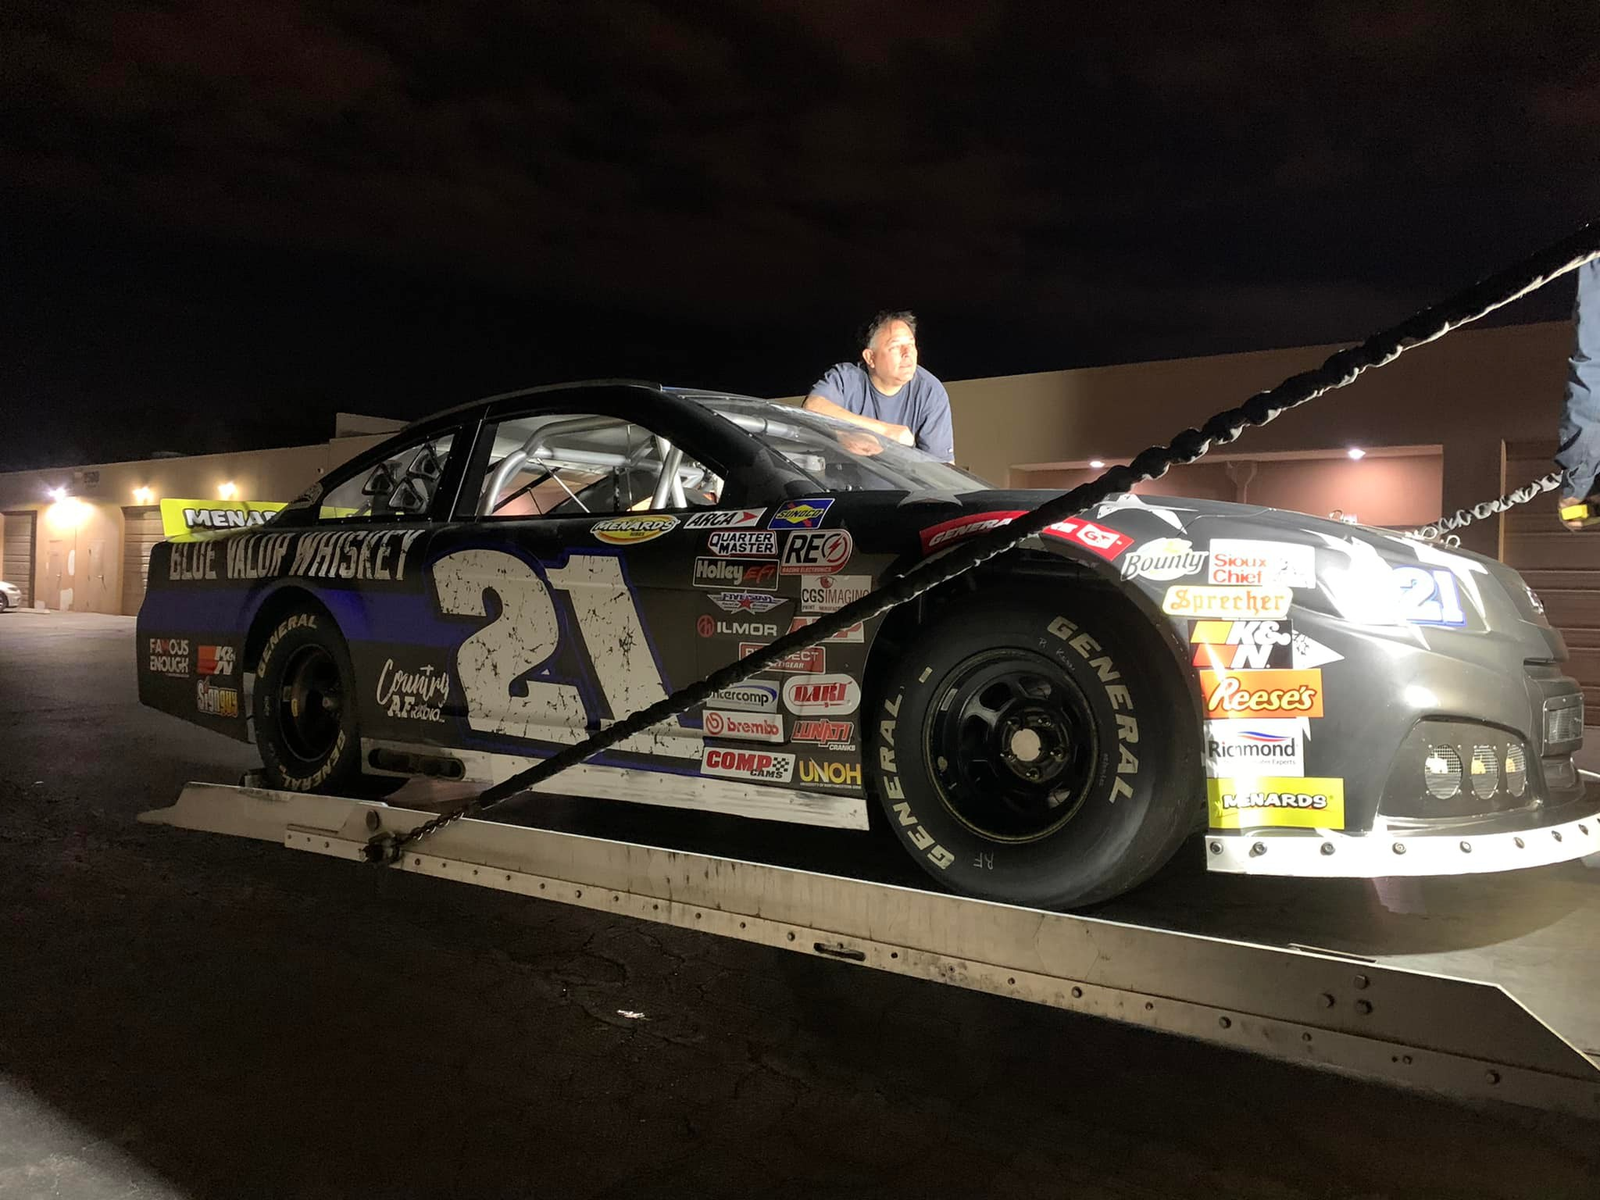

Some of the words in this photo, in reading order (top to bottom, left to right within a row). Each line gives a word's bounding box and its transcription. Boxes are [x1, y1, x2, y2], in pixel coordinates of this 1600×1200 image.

[183, 508, 278, 529] MENA
[687, 511, 738, 527] ARCA
[777, 509, 823, 518] SUNOCO
[594, 519, 676, 533] MENARDS
[928, 517, 1013, 547] GENERA
[709, 532, 773, 547] QUARTER
[718, 542, 774, 554] MASTER
[169, 541, 217, 581] BLUE
[226, 532, 296, 579] VALOR
[288, 529, 426, 581] WHISKEY
[1122, 551, 1208, 580] Bounty
[1213, 553, 1267, 568] Sioux
[696, 559, 744, 586] Holley
[1212, 569, 1263, 584] Chief
[1169, 588, 1286, 616] Sprecher
[1392, 565, 1467, 627] 21
[716, 621, 778, 637] ILMOR
[257, 613, 319, 679] GENERAL
[432, 549, 704, 760] 21
[149, 655, 189, 674] ENOUGH
[376, 658, 450, 709] Country
[1207, 676, 1318, 712] Reese's
[710, 690, 769, 707] ntercomp
[1046, 615, 1140, 804] GENERAL
[726, 716, 780, 737] brembo
[792, 720, 852, 744] LUNATI
[281, 729, 346, 792] GENERAL
[706, 750, 773, 771] COMP
[799, 756, 862, 785] UNOH
[750, 768, 783, 779] CAMS
[879, 693, 955, 870] GENERAL
[1222, 792, 1328, 810] MENARDS
